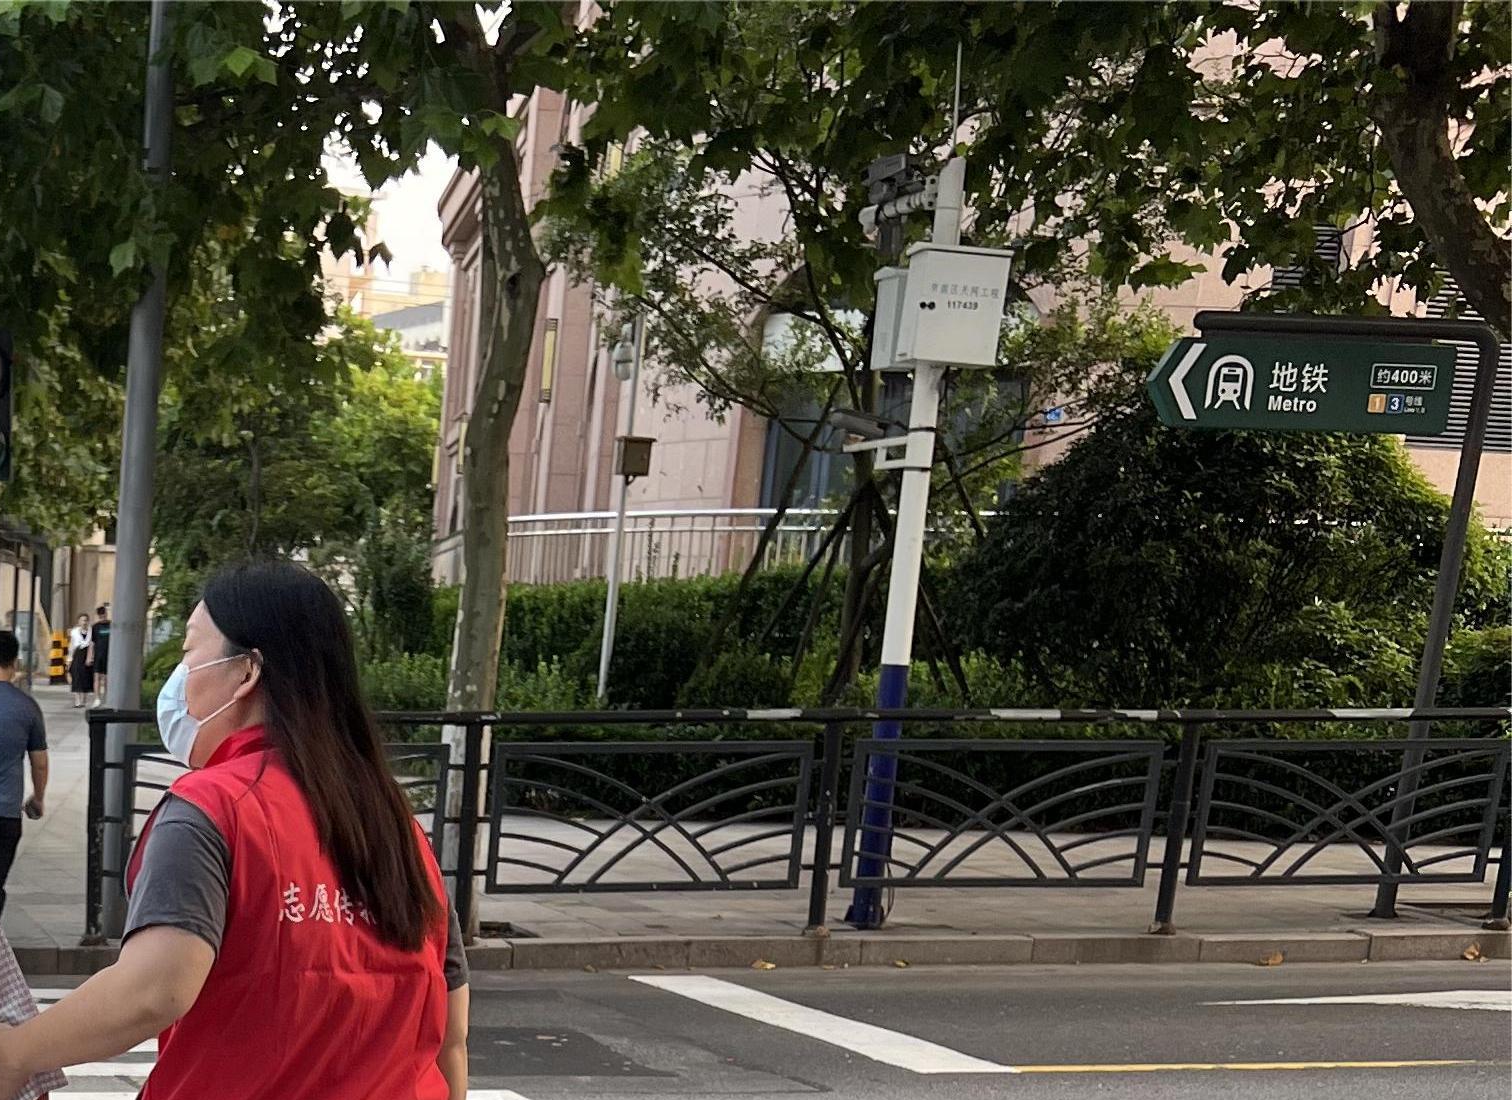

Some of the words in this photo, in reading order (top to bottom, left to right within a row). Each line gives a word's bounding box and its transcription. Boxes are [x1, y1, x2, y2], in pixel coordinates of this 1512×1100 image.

[1268, 361, 1329, 394] 地铁
[1376, 368, 1433, 386] 约400米
[1268, 395, 1317, 413] Metro
[278, 881, 376, 926] 志愿传
